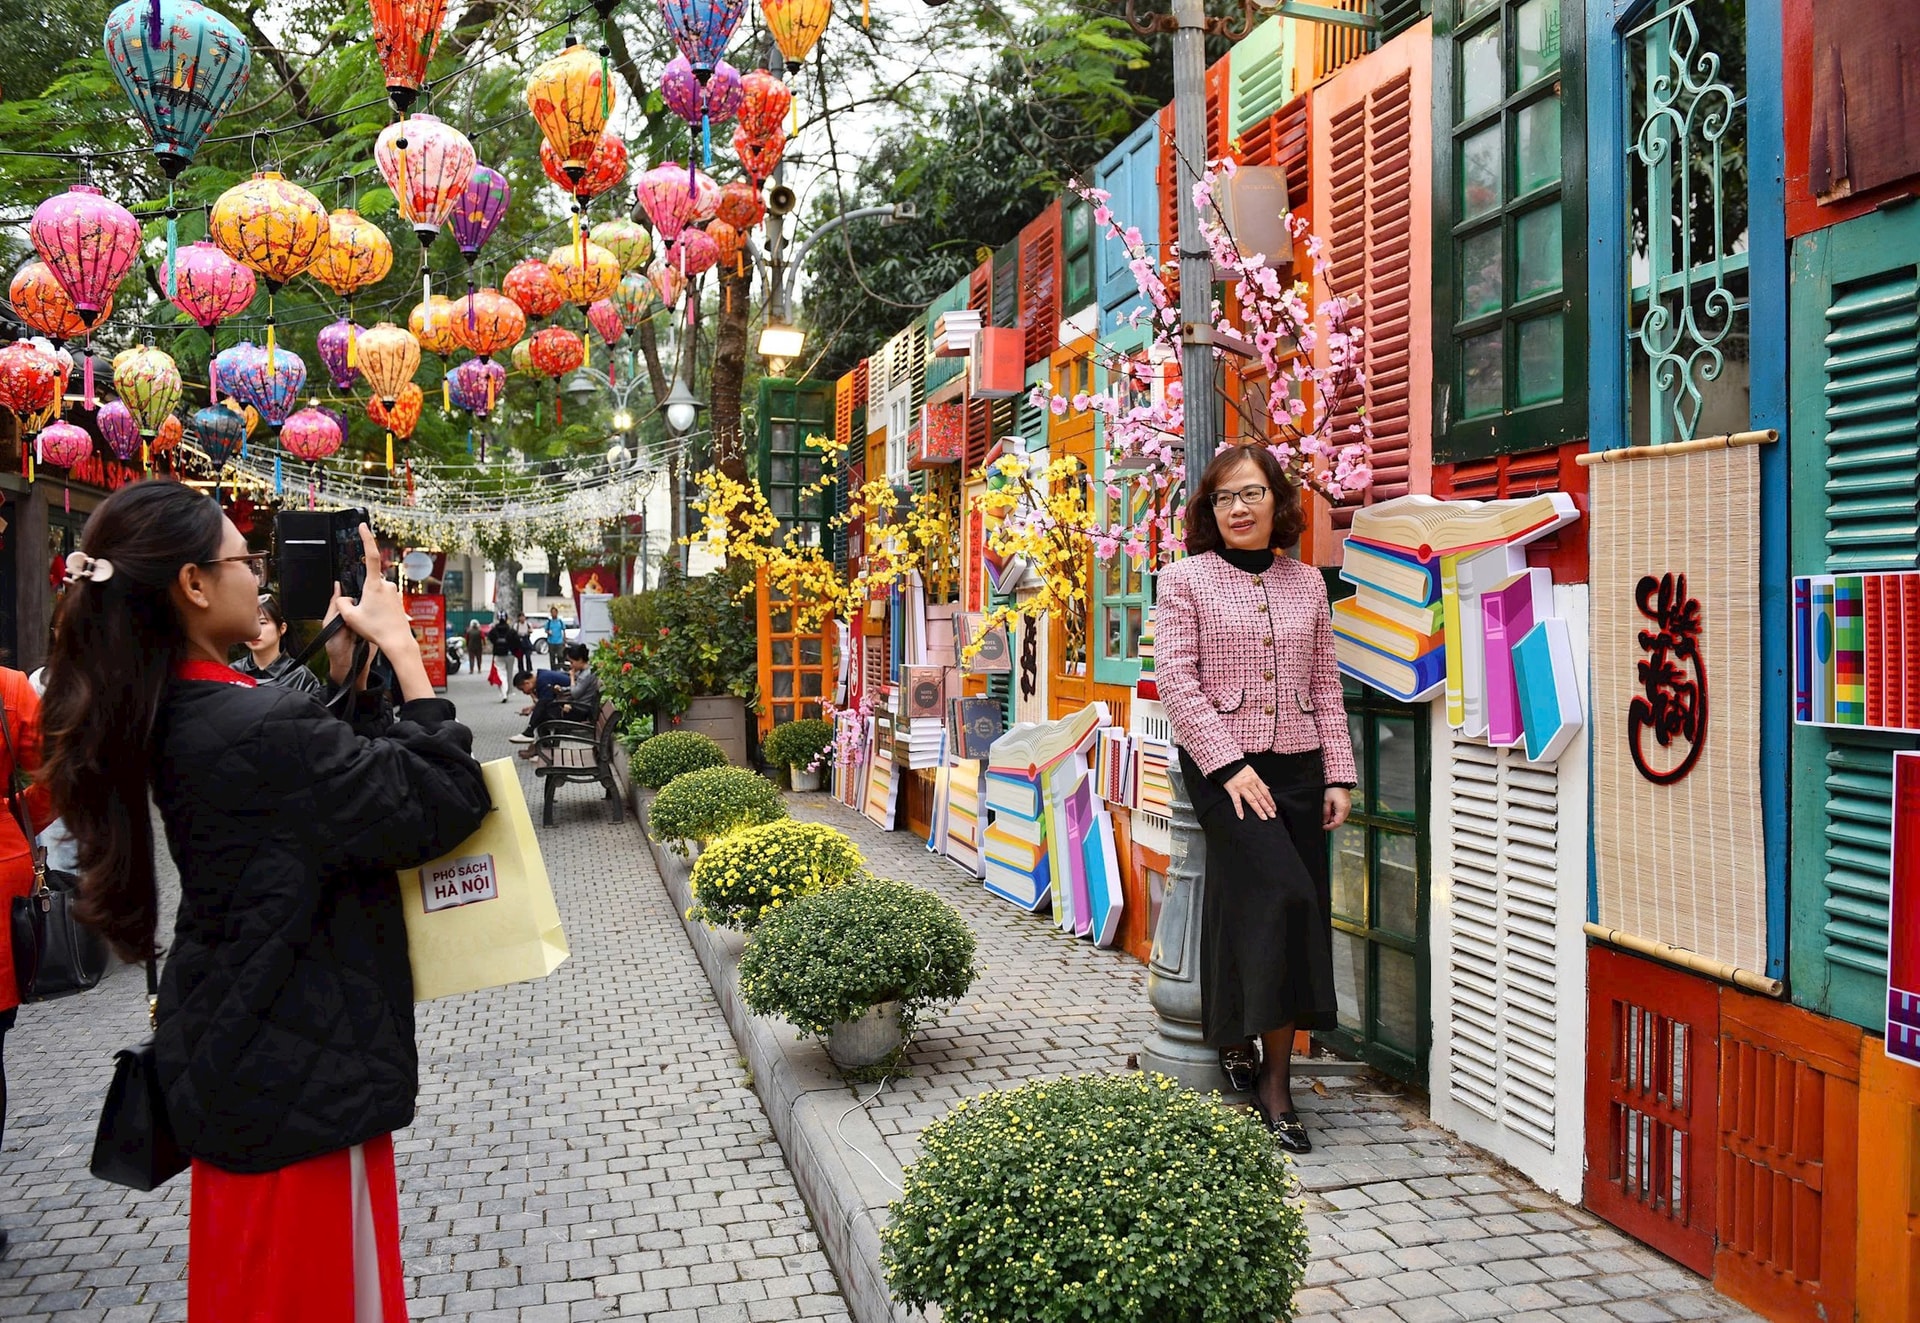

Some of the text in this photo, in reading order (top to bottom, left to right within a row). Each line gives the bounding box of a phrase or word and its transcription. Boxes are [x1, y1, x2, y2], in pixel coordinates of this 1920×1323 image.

[433, 862, 488, 882] PHỐ SÁCH
[435, 875, 490, 899] HÀ NỘI
